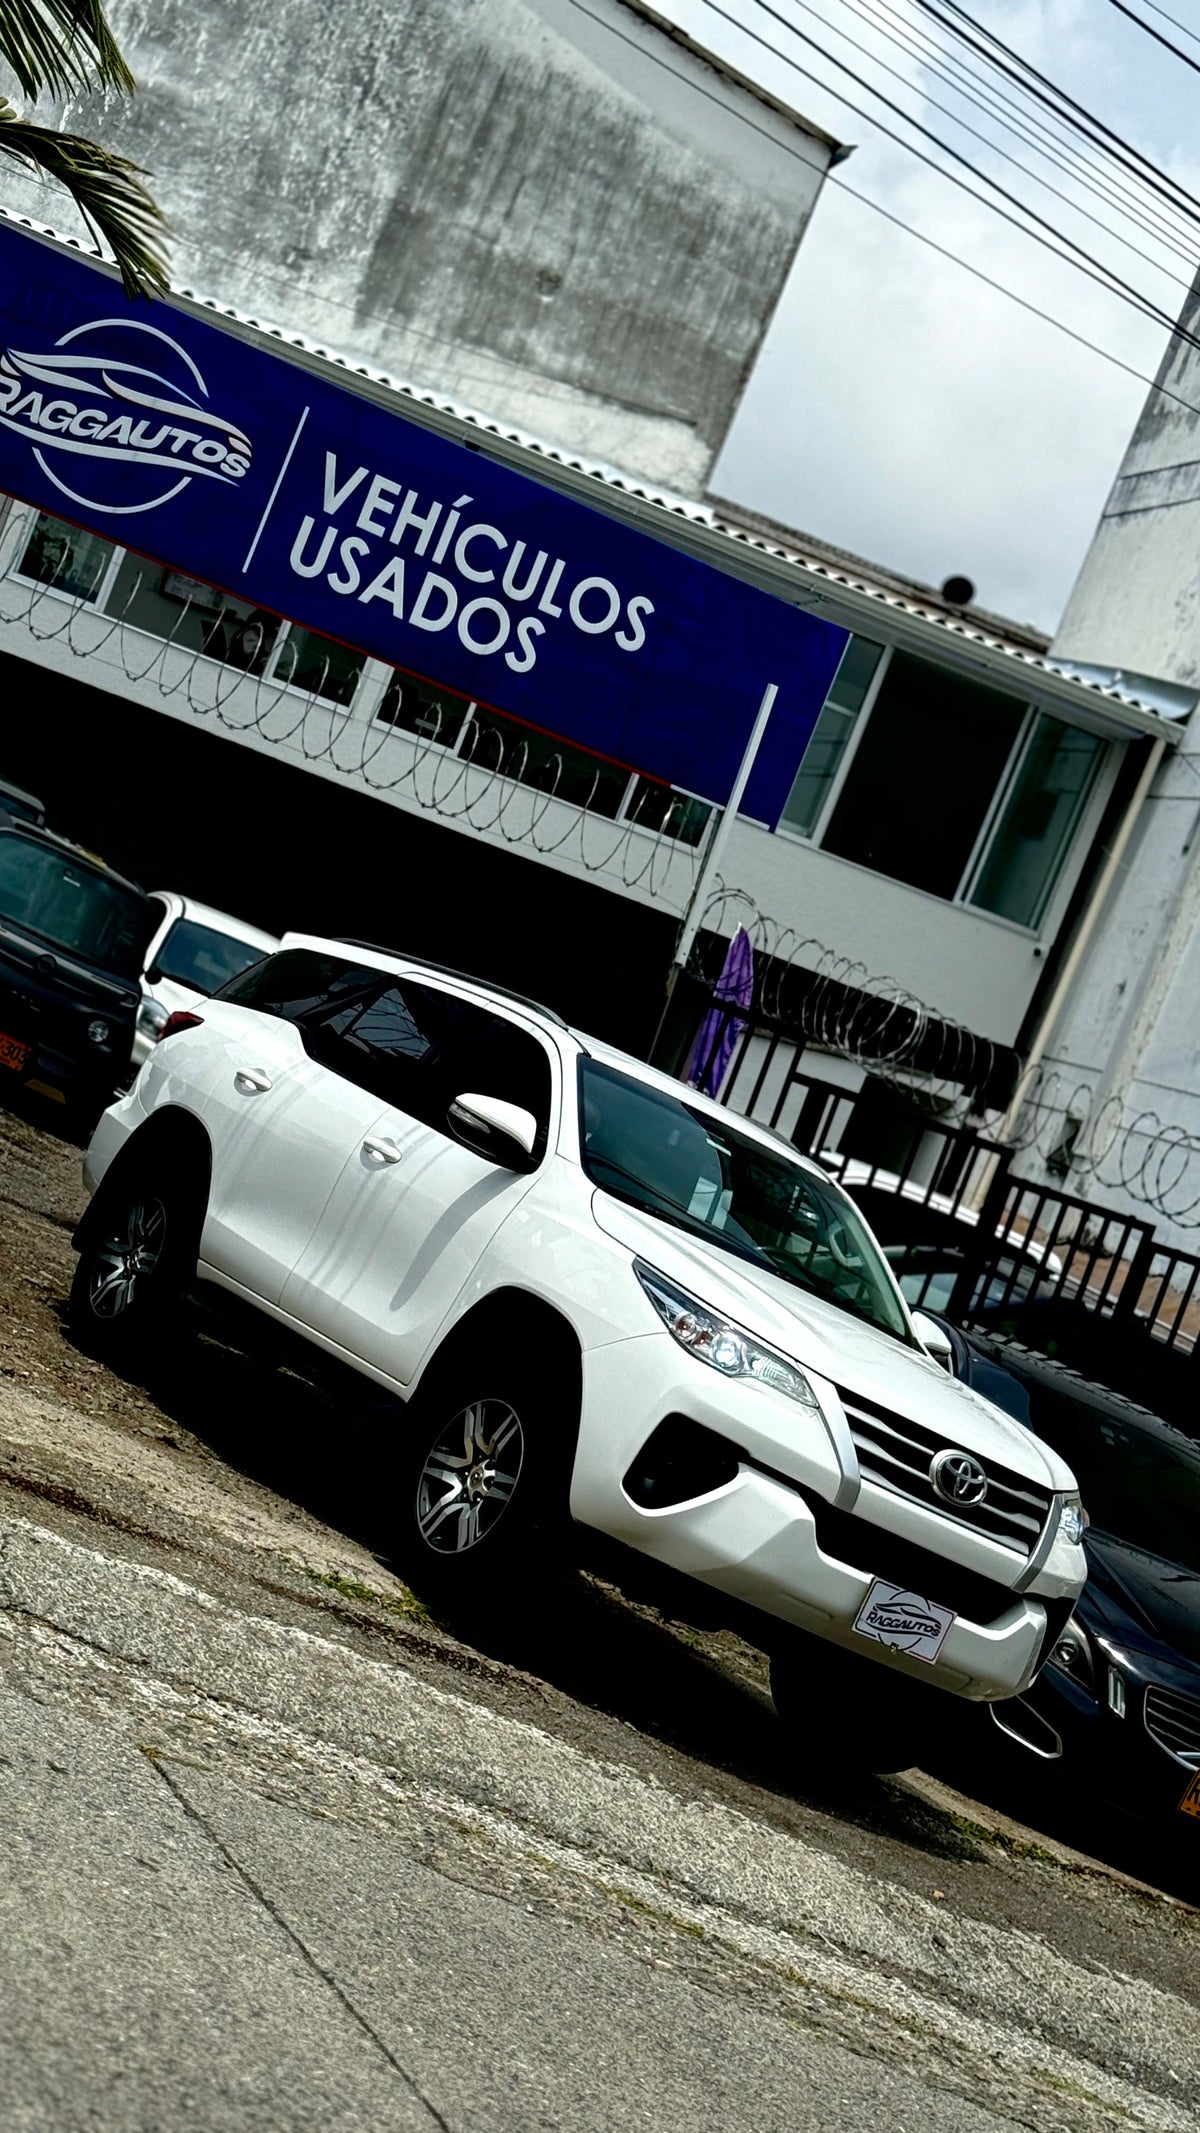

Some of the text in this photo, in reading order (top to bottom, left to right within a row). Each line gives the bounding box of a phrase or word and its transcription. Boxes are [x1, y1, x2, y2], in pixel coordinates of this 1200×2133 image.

[0, 374, 251, 478] RAGGAUTOS
[289, 515, 546, 673] USADOS
[322, 450, 655, 652] VEHÍCULOS
[865, 1611, 941, 1637] RAGGAUTOS
